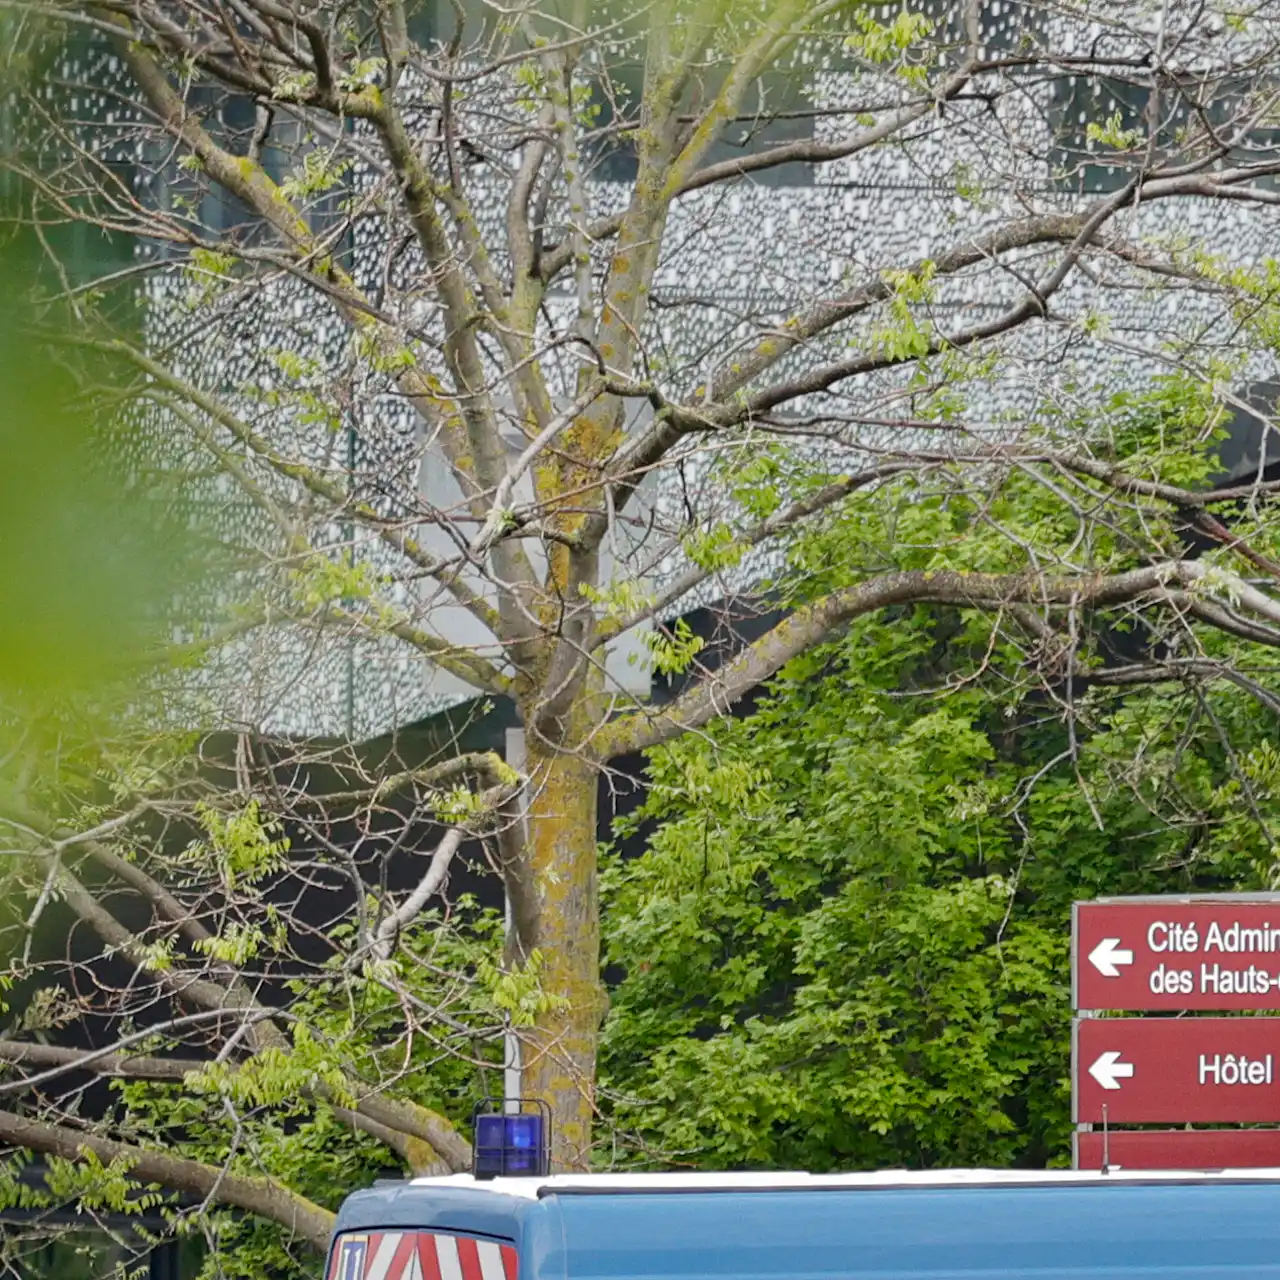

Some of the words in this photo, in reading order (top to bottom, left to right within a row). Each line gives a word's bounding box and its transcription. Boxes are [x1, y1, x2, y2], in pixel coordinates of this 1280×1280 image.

[1147, 920, 1199, 953] Cité
[1149, 962, 1194, 994] des
[1198, 1053, 1272, 1085] Hôtel
